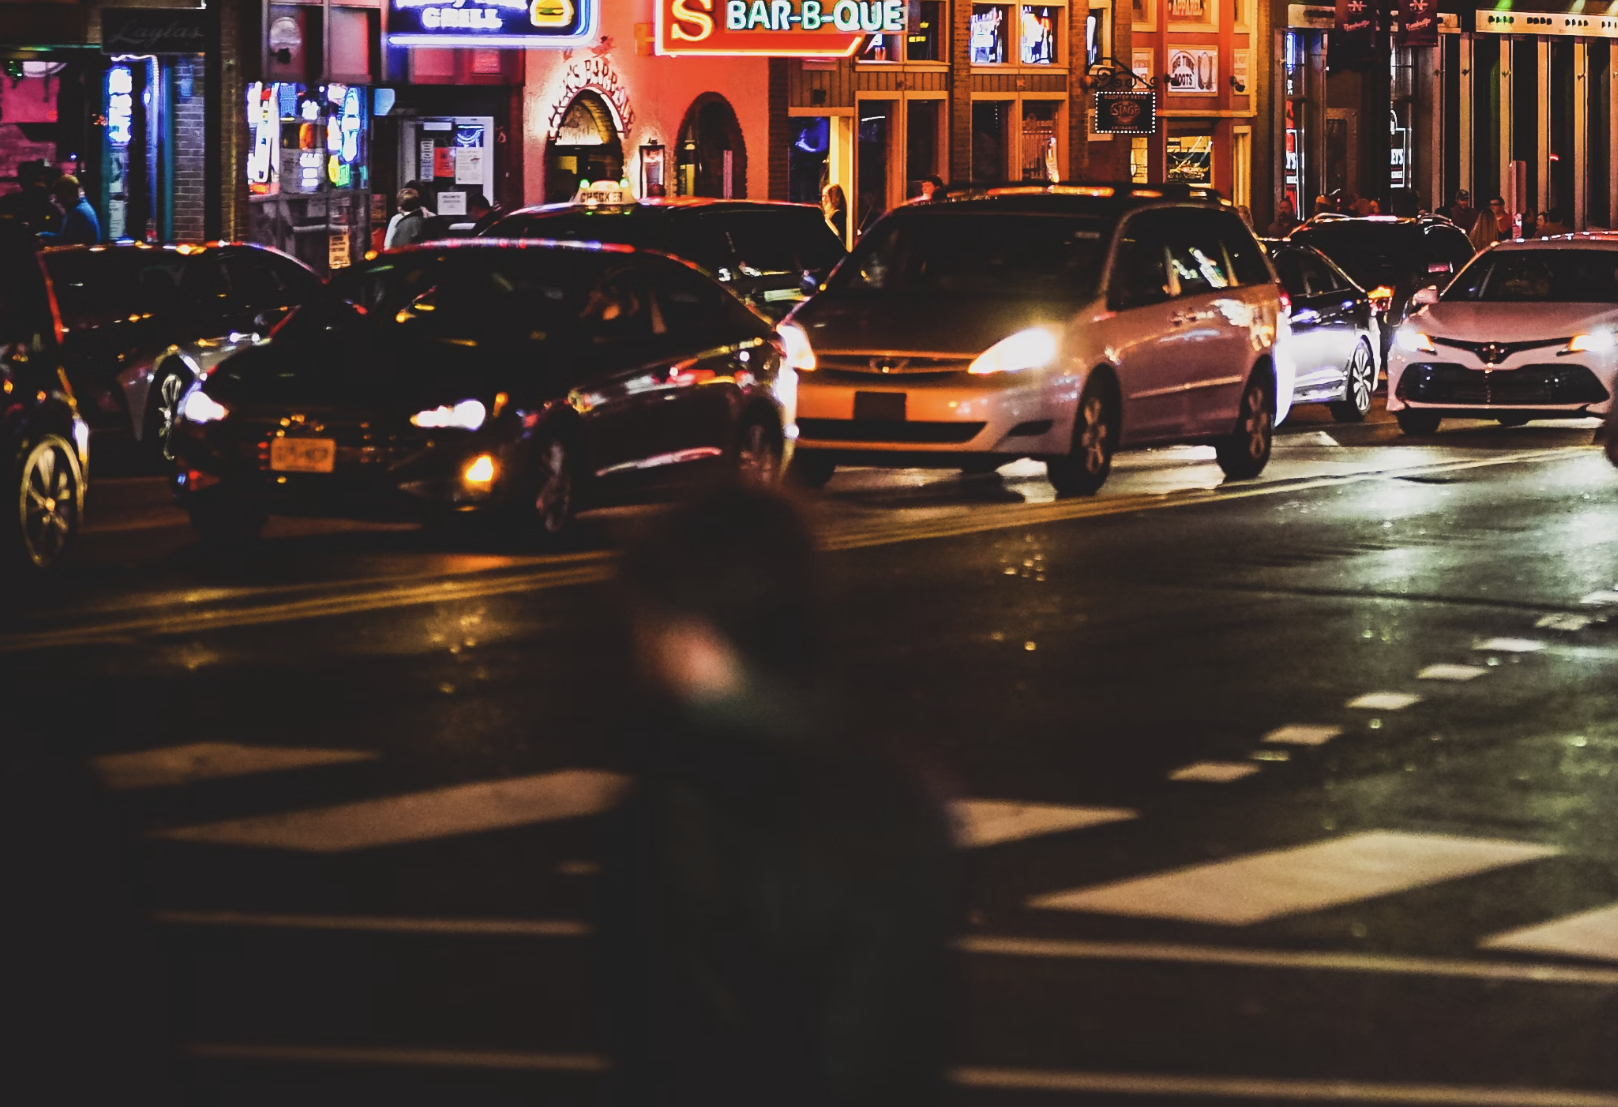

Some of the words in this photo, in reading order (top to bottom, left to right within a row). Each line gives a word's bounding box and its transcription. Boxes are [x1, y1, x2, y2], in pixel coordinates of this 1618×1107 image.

[422, 8, 503, 28] GRILL
[726, 0, 905, 31] BAR-B-QUE
[1110, 101, 1139, 116] STAGE
